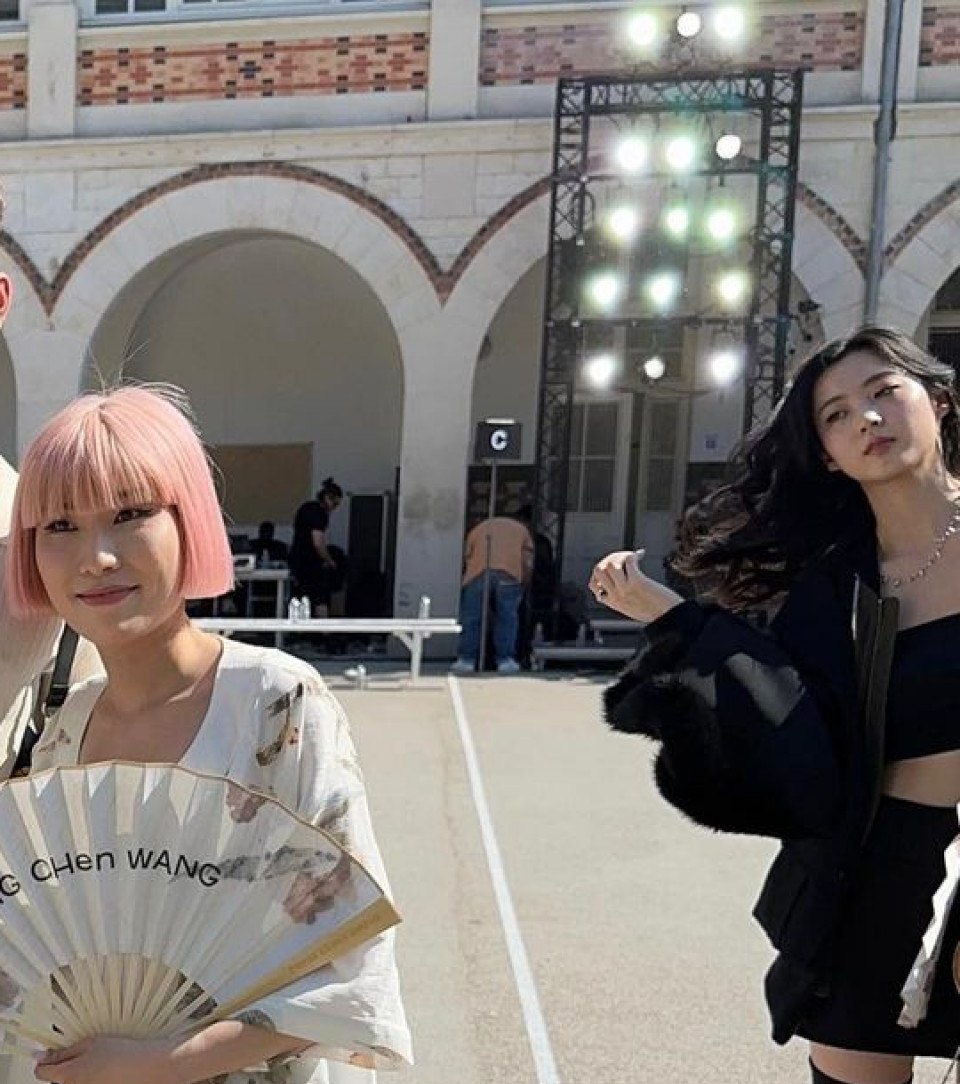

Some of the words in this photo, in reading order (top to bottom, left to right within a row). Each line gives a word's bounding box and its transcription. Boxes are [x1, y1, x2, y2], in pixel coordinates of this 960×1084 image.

[490, 429, 508, 451] C
[30, 850, 115, 883] CHen
[127, 847, 222, 888] WANG
